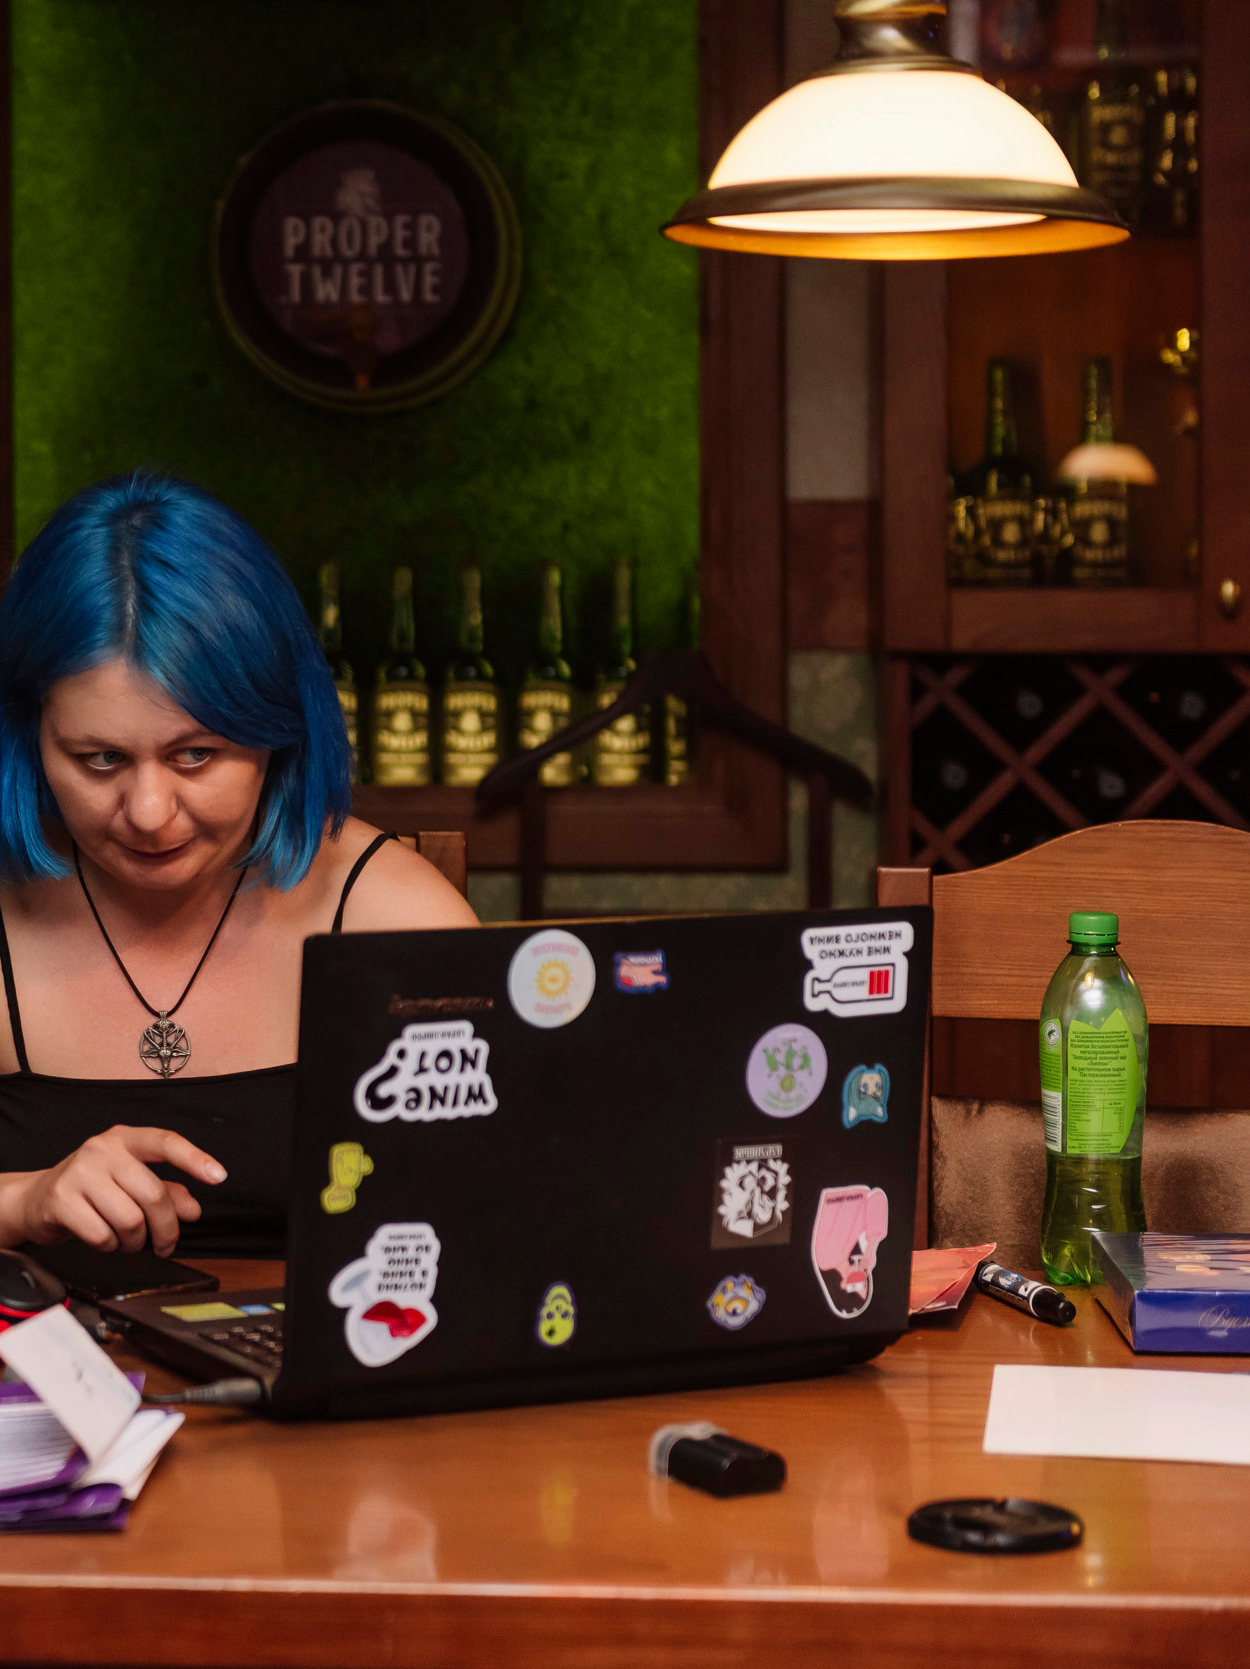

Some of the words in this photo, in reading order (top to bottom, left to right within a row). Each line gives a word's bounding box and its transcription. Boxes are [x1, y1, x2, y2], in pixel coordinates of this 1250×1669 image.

[282, 213, 441, 258] PROPER
[283, 261, 441, 304] TWELVE
[809, 934, 841, 945] ВИНА
[845, 930, 902, 943] НЕМНОГО
[819, 947, 863, 960] НУЖНО
[867, 945, 891, 957] МНЕ
